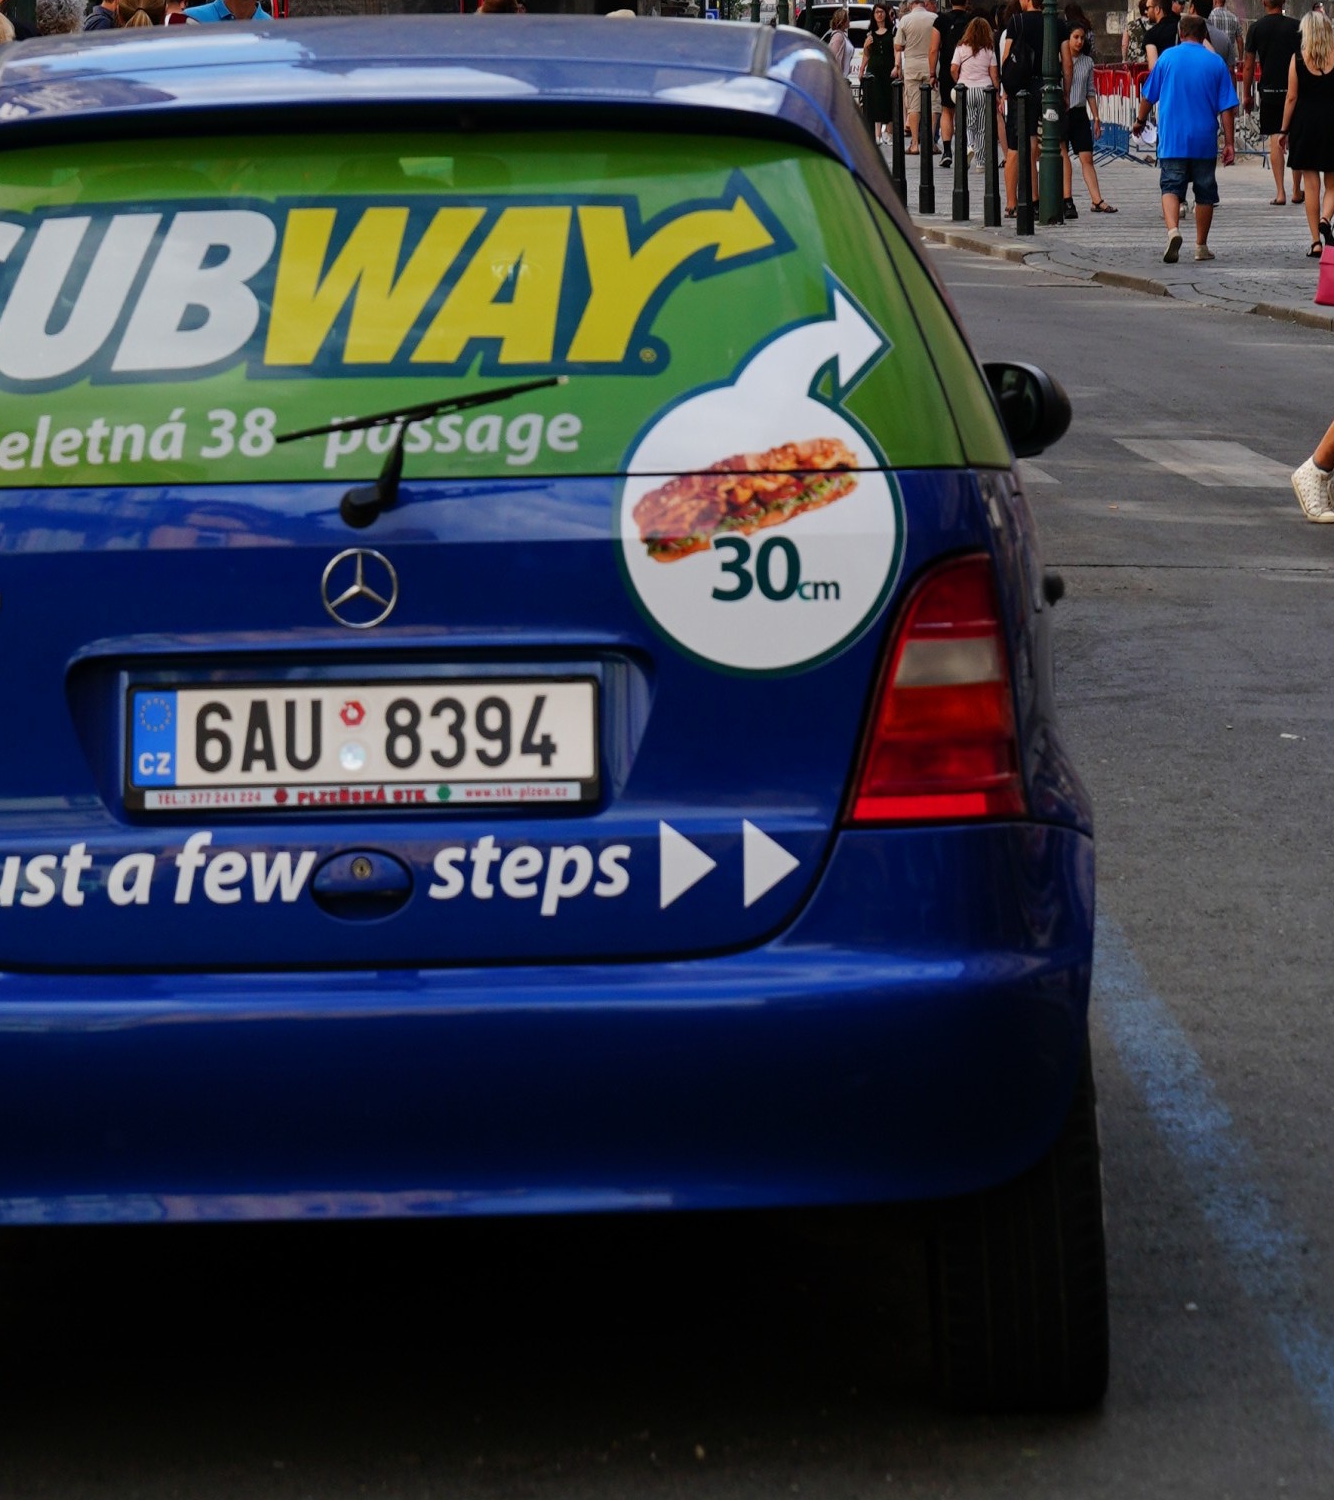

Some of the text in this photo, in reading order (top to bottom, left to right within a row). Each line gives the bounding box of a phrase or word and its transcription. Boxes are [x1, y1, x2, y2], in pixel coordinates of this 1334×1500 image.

[200, 407, 278, 457] 38
[323, 410, 582, 470] passage
[139, 752, 171, 776] CZ
[195, 695, 557, 772] 6AU 8394
[107, 852, 156, 908] a
[174, 831, 318, 905] few
[429, 834, 632, 918] steps
